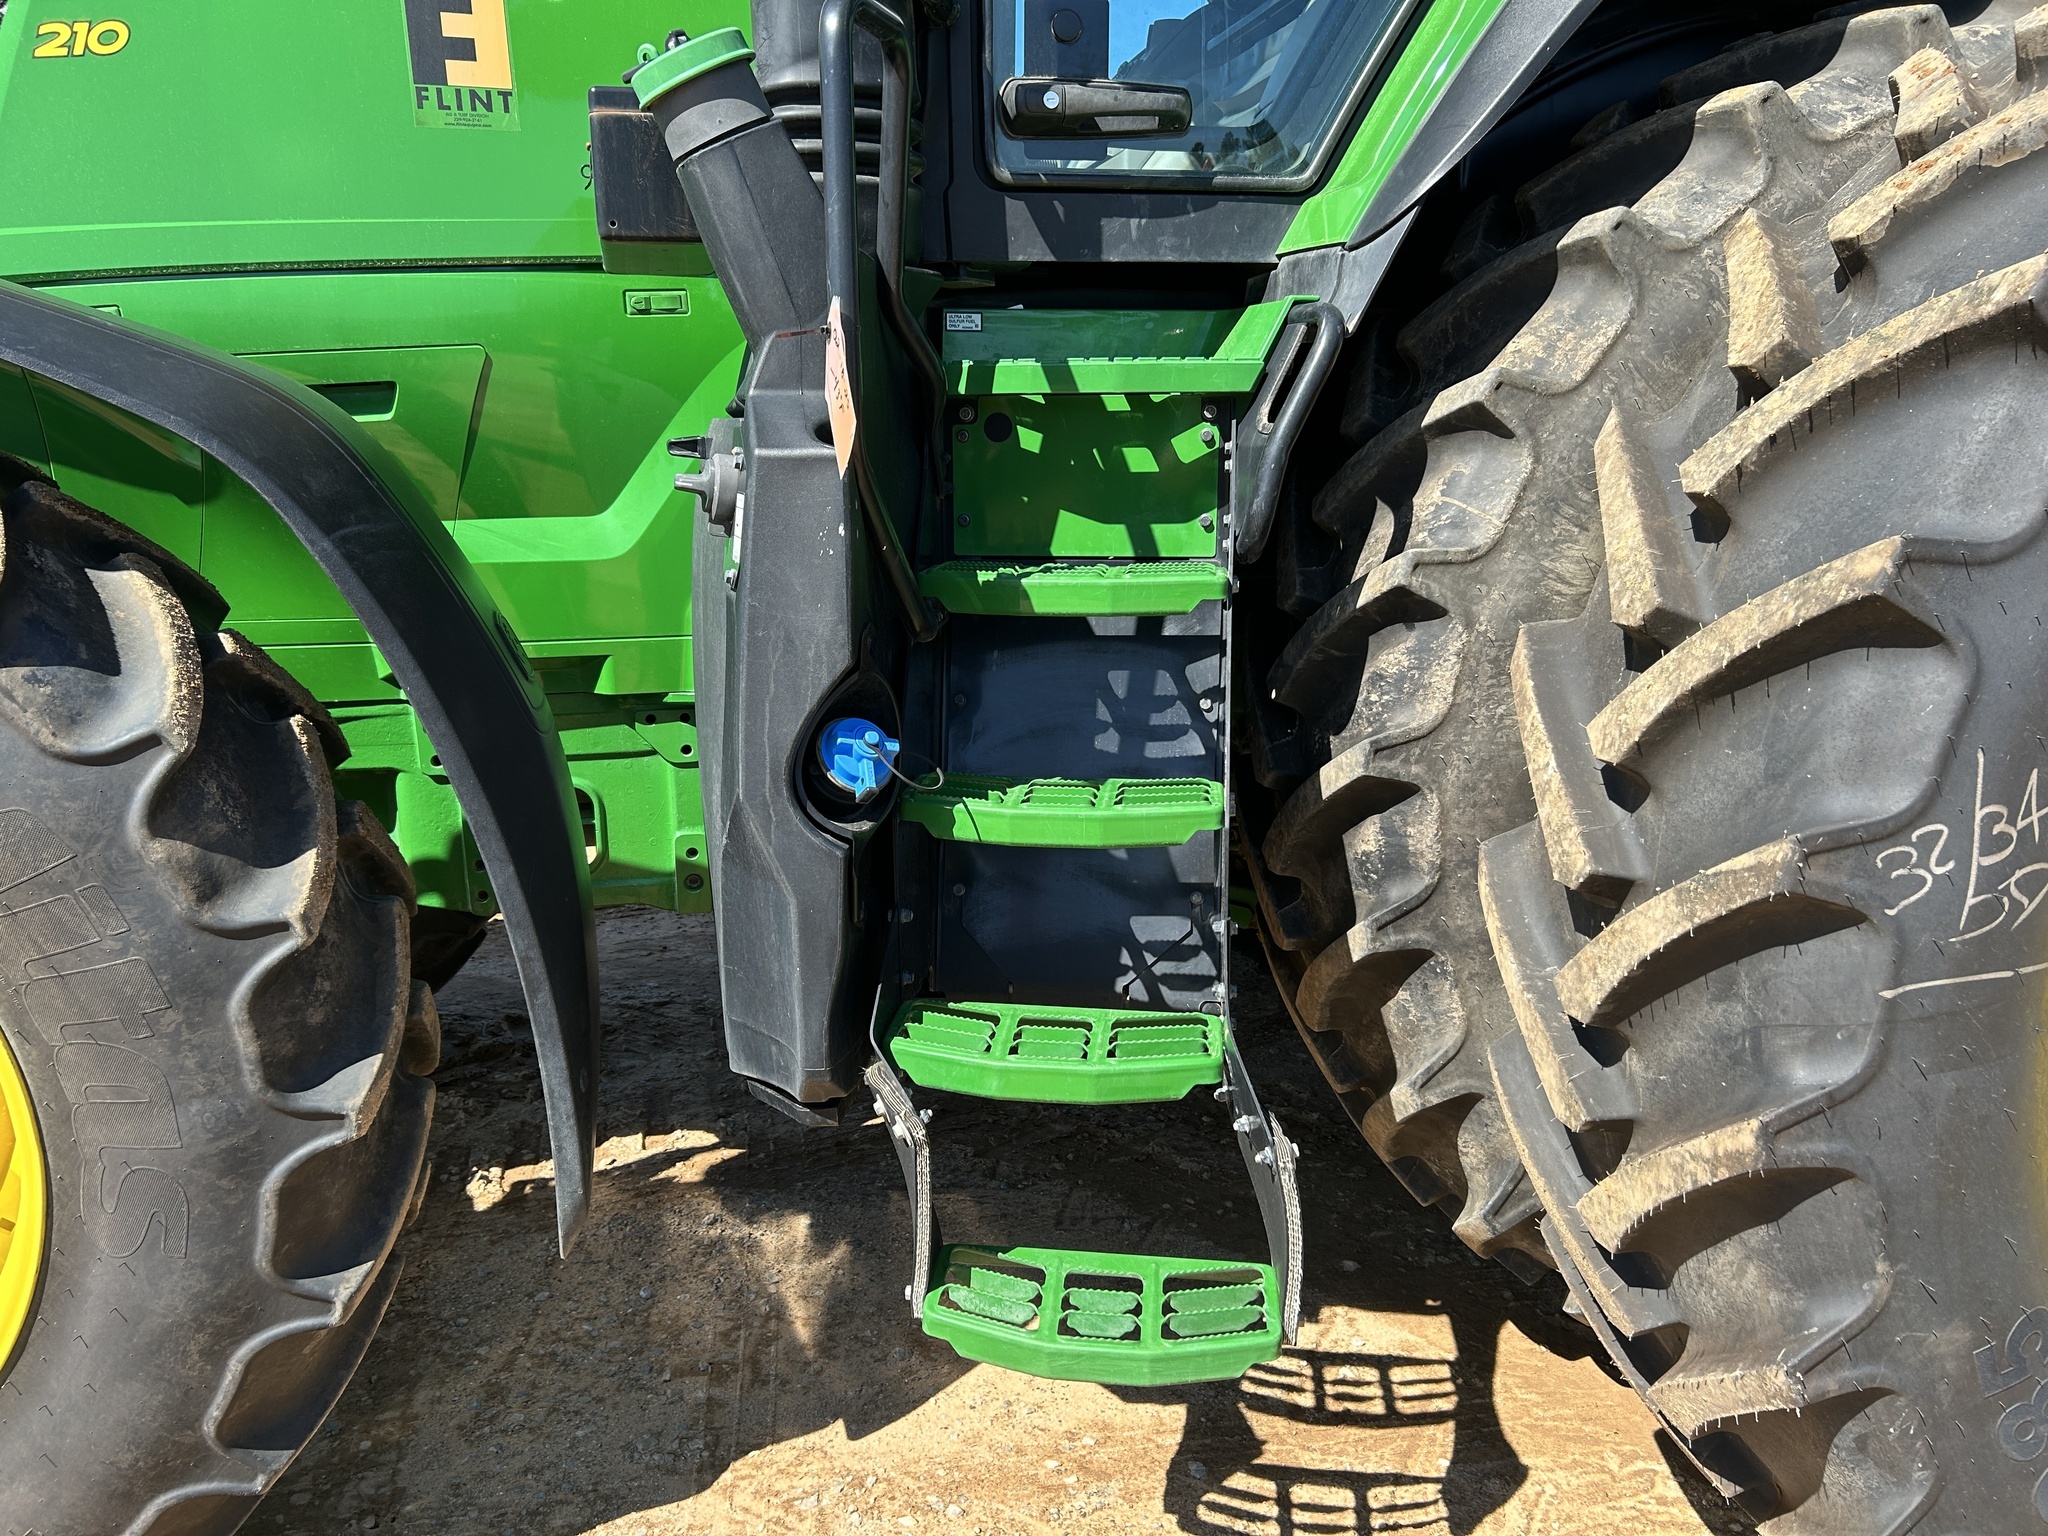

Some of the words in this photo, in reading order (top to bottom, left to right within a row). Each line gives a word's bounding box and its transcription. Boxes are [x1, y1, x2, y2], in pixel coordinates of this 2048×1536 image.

[33, 19, 131, 59] 210
[415, 86, 513, 114] FLINT
[0, 806, 189, 1258] itas
